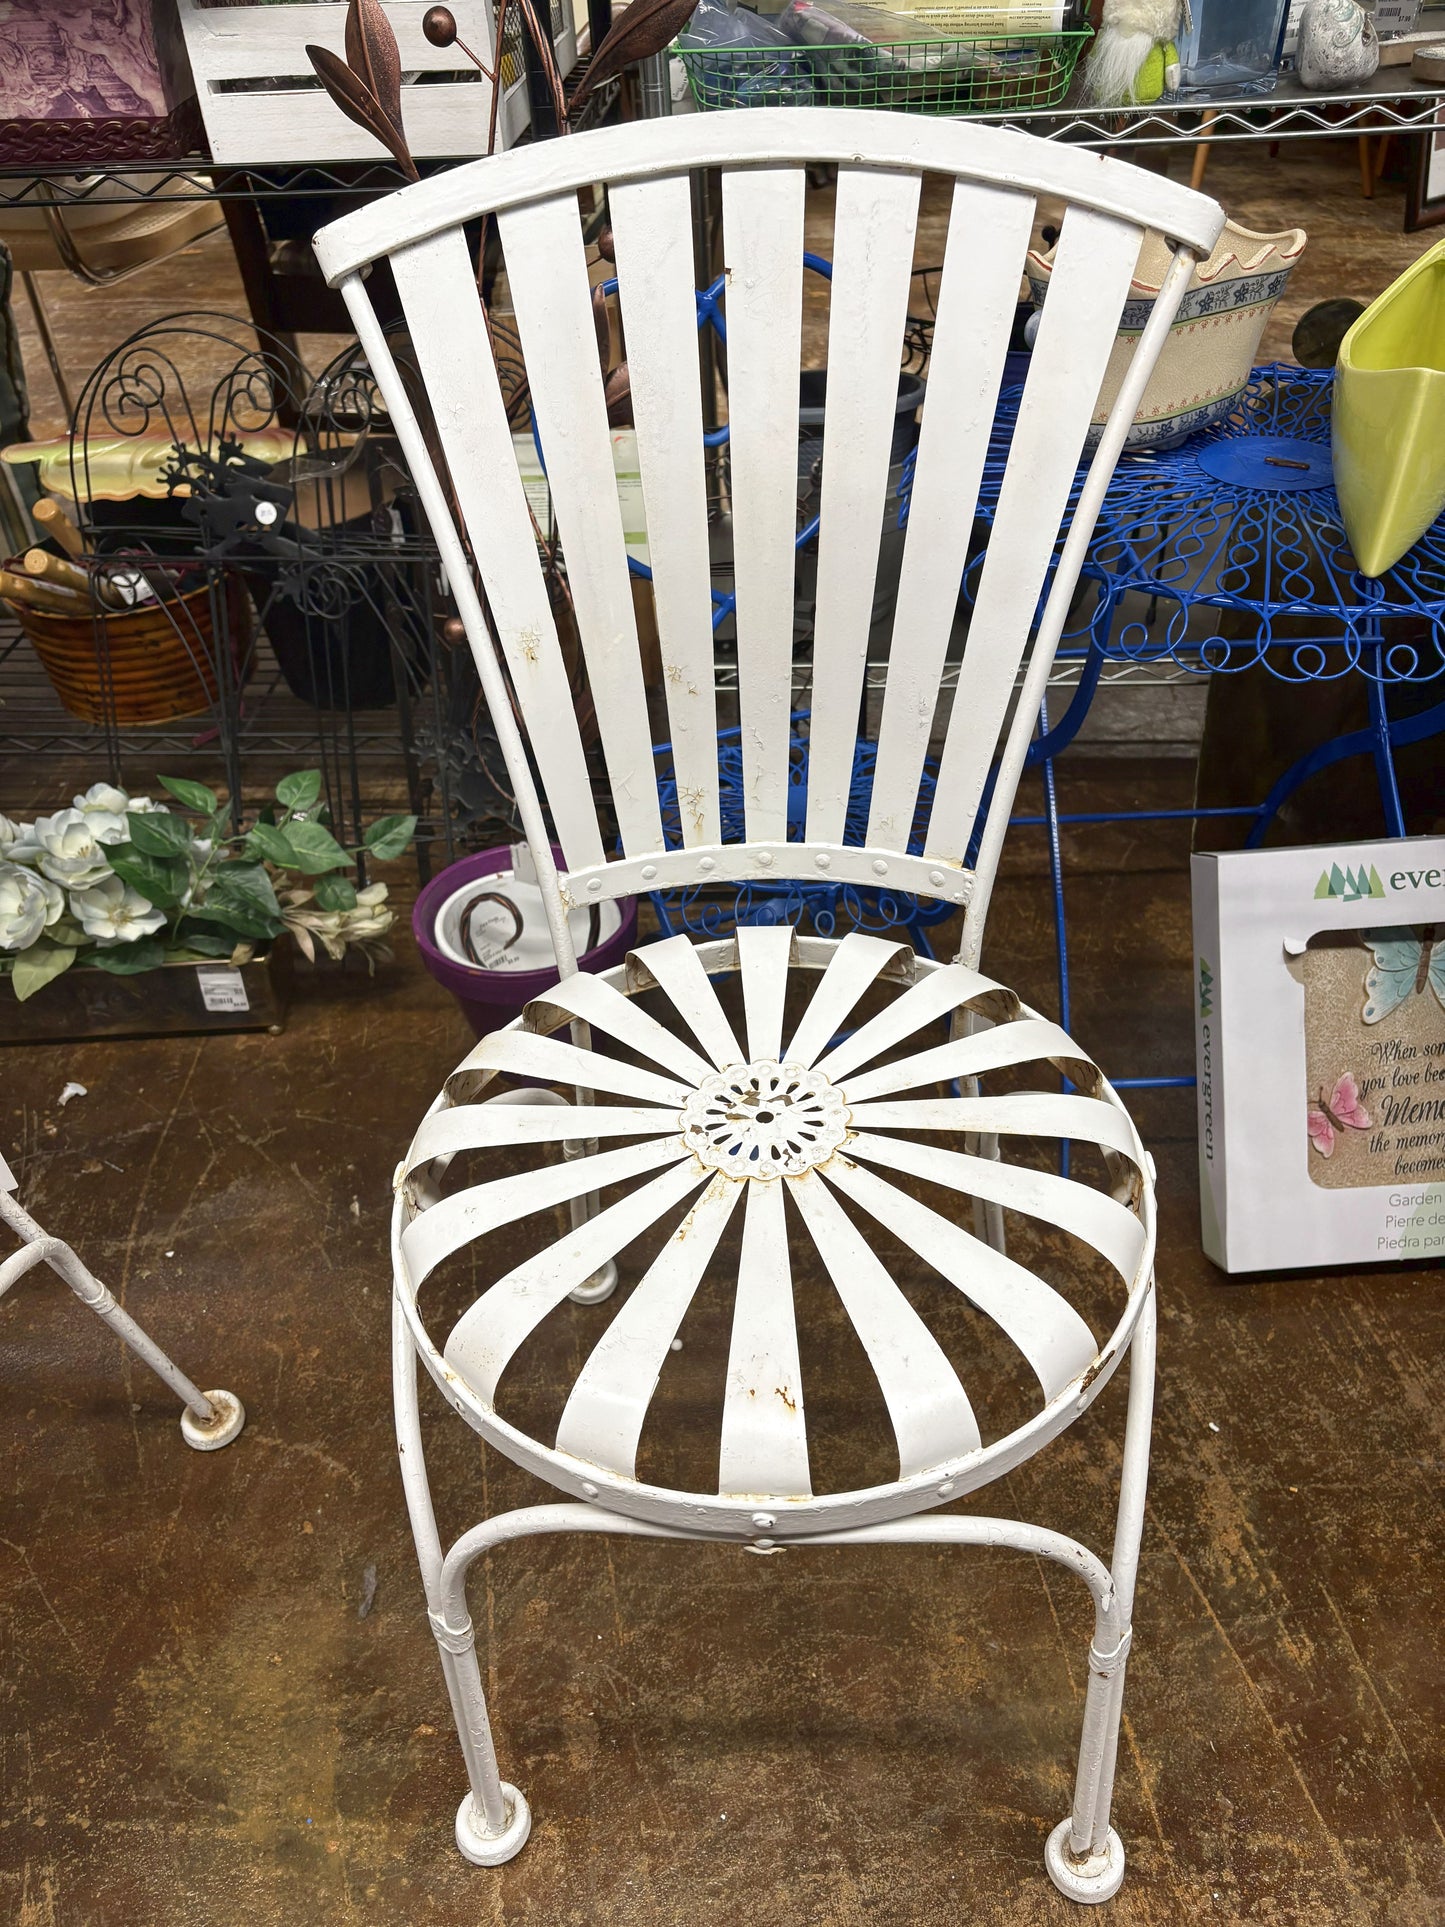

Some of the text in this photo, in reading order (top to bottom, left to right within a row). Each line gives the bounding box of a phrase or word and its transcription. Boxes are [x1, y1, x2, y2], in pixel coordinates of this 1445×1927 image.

[1390, 869, 1445, 890] eve
[1371, 1039, 1417, 1064] When
[1202, 1024, 1214, 1160] evergreen
[1360, 1077, 1386, 1101] you
[1393, 1066, 1420, 1087] love
[1369, 1132, 1390, 1153] the
[1395, 1155, 1445, 1176] become
[1389, 1192, 1442, 1207] Garden
[1386, 1212, 1445, 1229] Pierre de
[1378, 1235, 1420, 1250] Piedra
